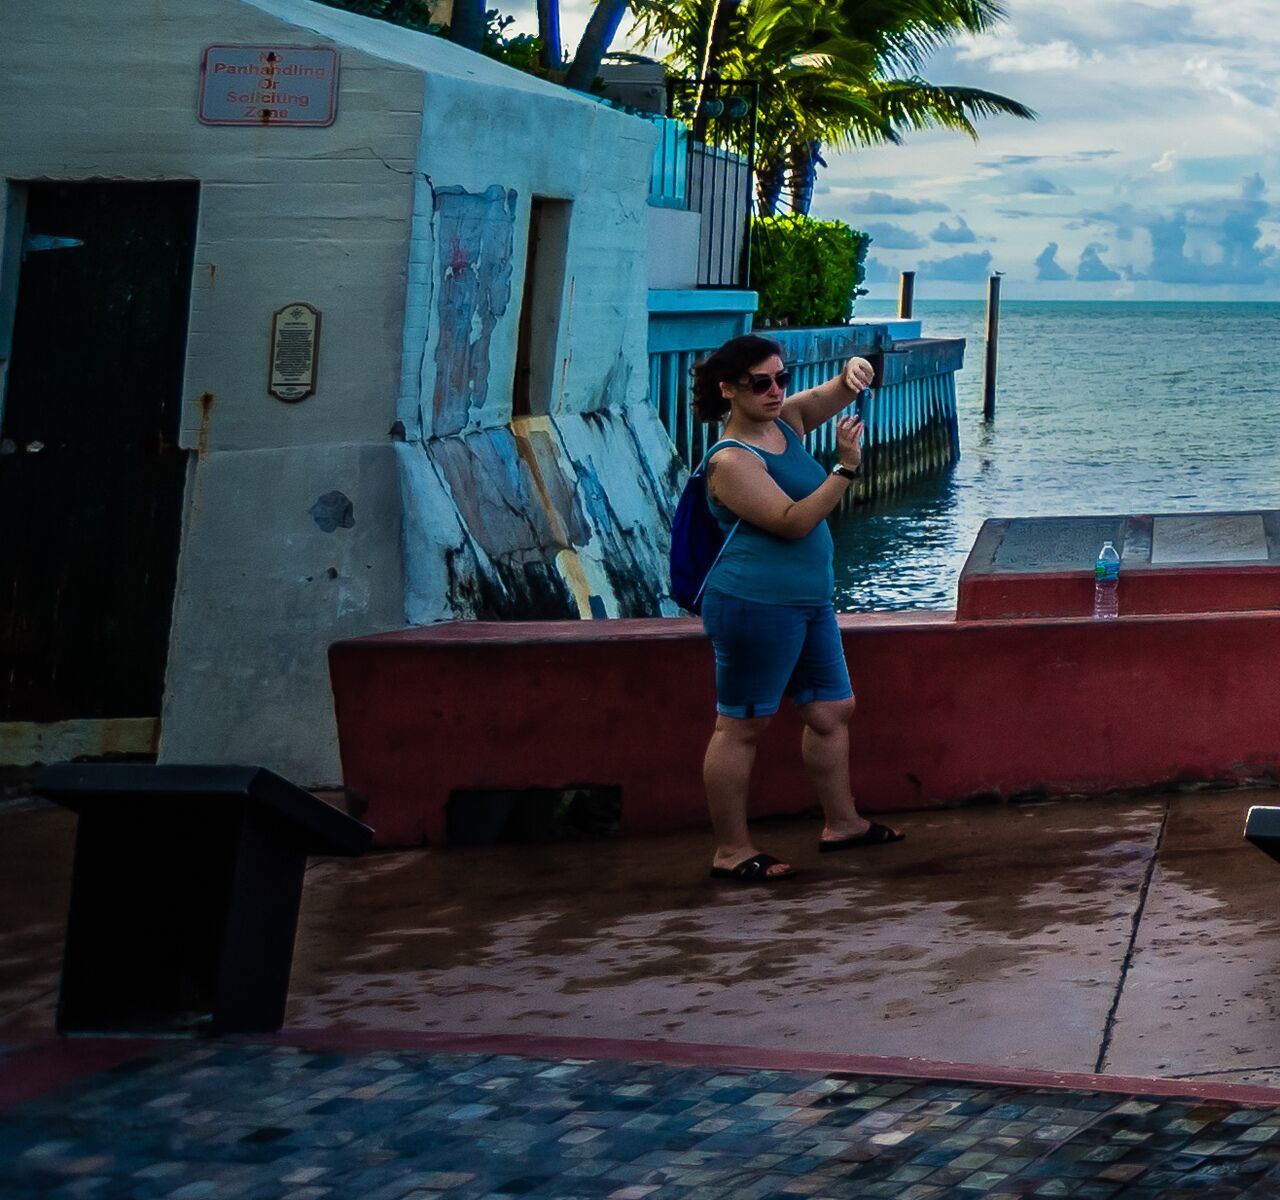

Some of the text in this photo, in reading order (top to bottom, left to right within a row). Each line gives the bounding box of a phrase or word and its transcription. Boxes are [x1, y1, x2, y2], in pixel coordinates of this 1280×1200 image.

[214, 63, 326, 79] Panhandling
[259, 79, 280, 89] Or
[226, 91, 310, 107] Soliciting
